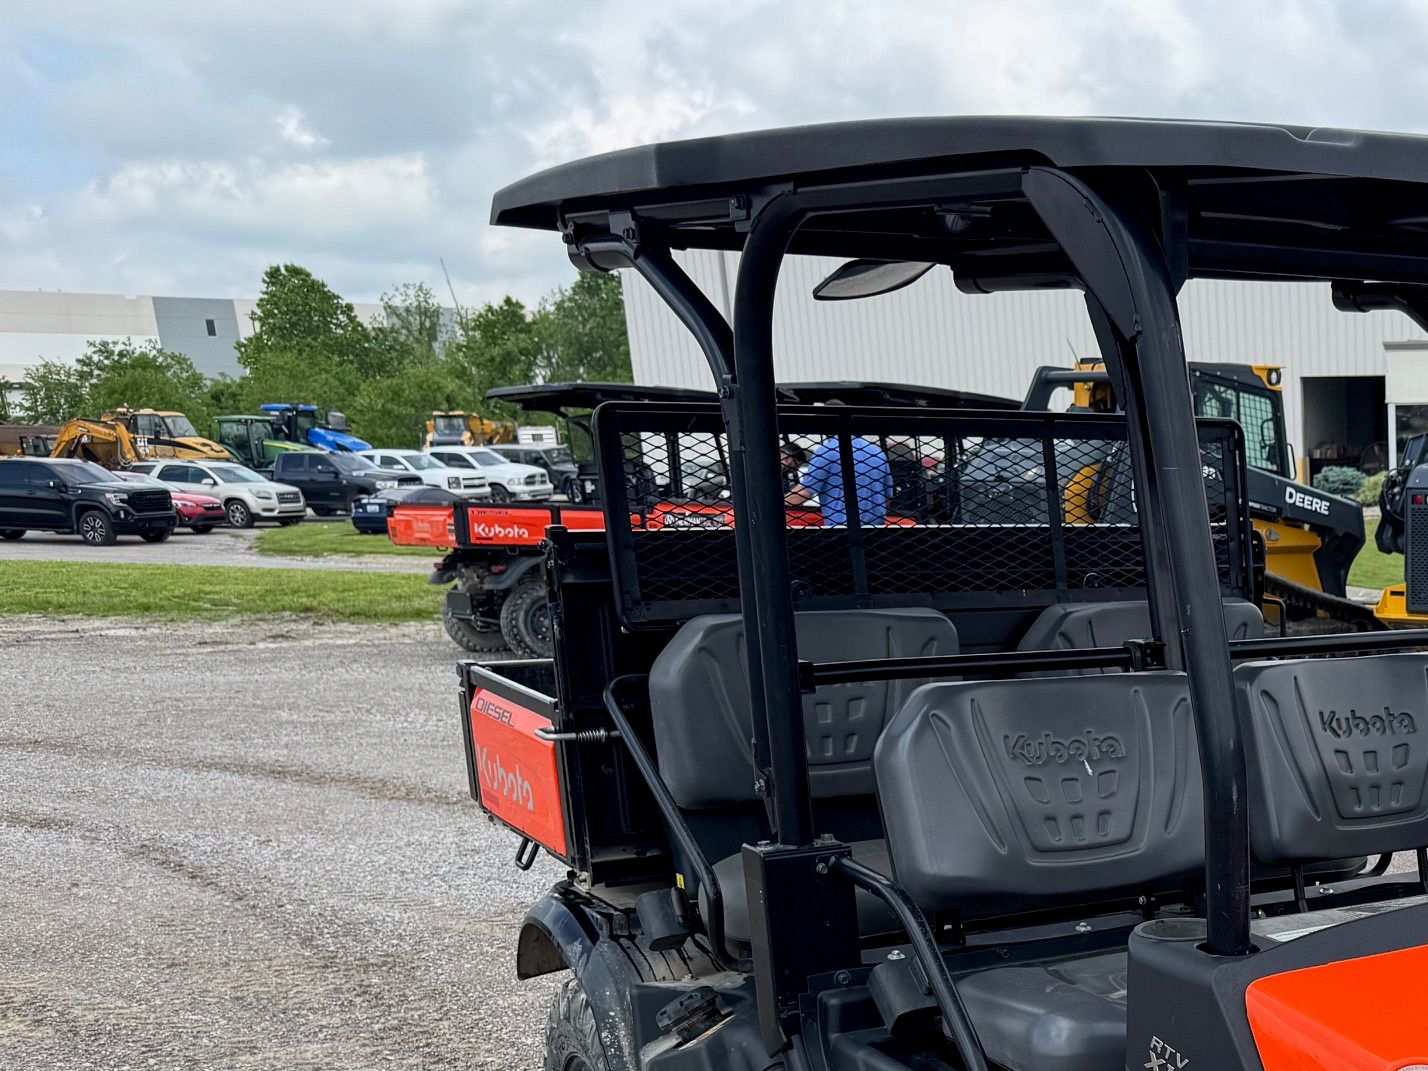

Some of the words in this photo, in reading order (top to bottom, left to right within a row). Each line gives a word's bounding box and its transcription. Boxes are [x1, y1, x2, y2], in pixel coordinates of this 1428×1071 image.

[1285, 486, 1330, 516] DEERE
[474, 522, 529, 539] Kubota
[475, 697, 515, 727] DIESEL
[1319, 706, 1416, 739] Kubota
[1003, 730, 1126, 766] Kubota
[477, 743, 535, 813] Kubota
[1150, 1035, 1190, 1070] RTV
